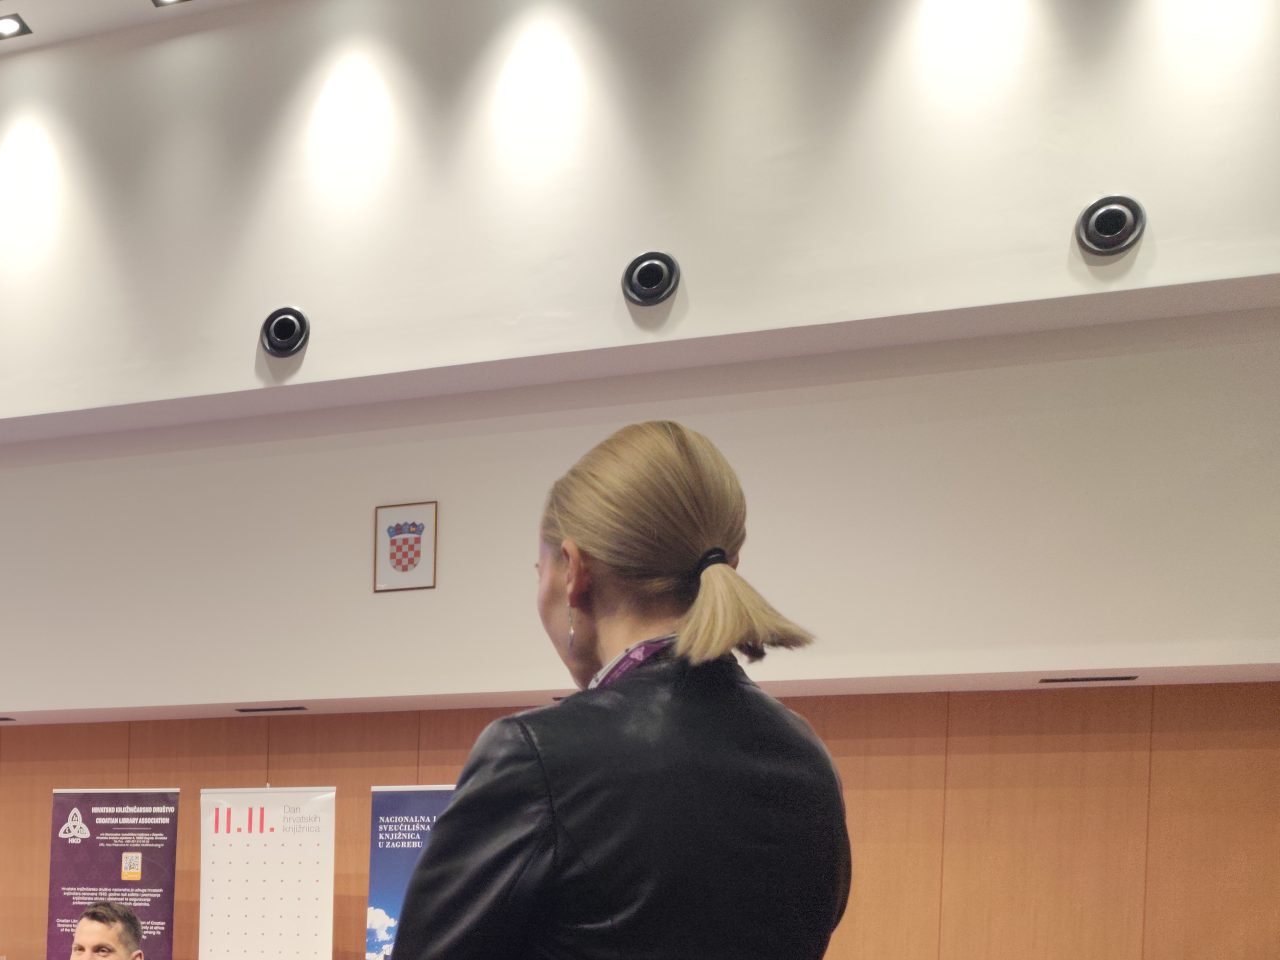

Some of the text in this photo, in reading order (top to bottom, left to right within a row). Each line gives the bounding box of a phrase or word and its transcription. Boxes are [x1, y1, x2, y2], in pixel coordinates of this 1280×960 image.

[283, 805, 301, 814] Dan
[282, 824, 320, 835] knjižnica
[379, 823, 431, 831] SVEUČILIŠNA
[379, 831, 421, 839] KNJIŽNICA
